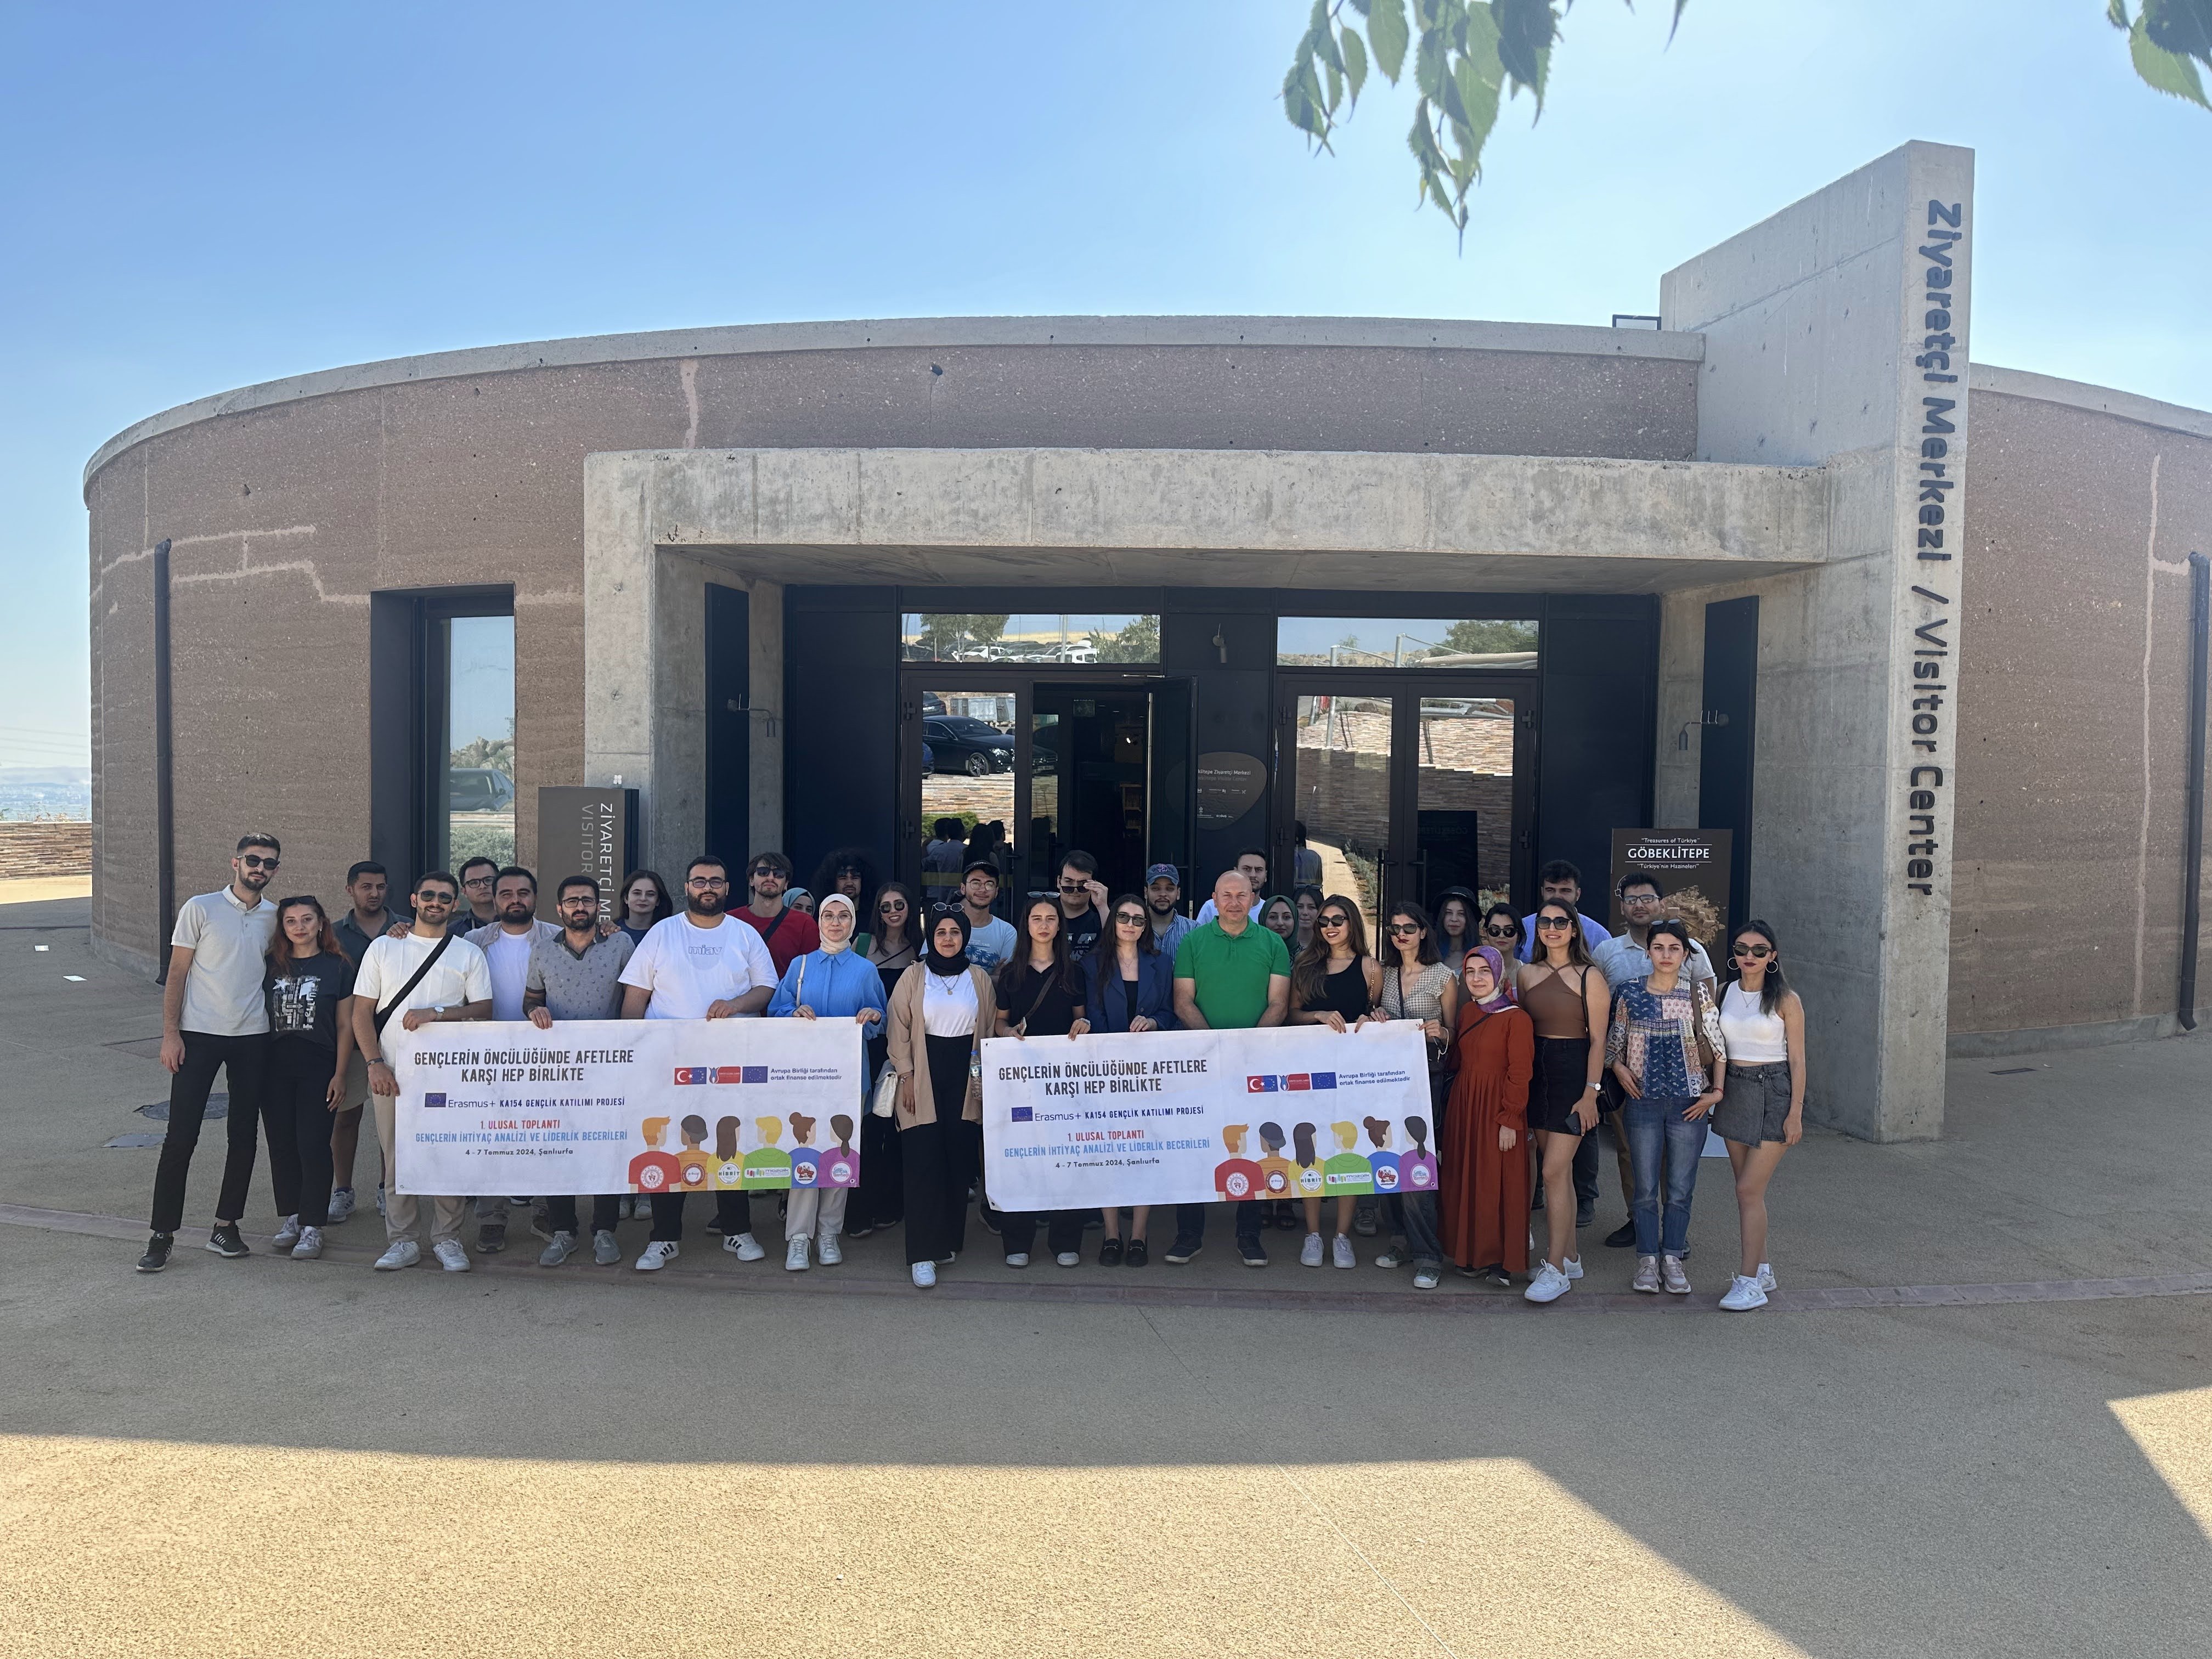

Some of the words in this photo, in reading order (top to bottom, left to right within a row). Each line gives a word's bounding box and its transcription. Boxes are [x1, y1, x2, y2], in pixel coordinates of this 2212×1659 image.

[1916, 199, 1962, 383] Ziyaretçi
[1917, 397, 1955, 561] Merkezi
[1912, 618, 1948, 753] Visitor
[582, 804, 594, 873] VISITOR
[1908, 766, 1943, 895] Center
[596, 803, 615, 891] ZİYARETÇİ
[1628, 846, 1709, 859] GÖBEKLİTEPE
[414, 1049, 479, 1069] GENÇLERİN
[484, 1048, 570, 1065] ÖNCÜLÜĞÜNDE
[575, 1049, 634, 1064] AFETLERE
[461, 1068, 496, 1085] KARŞI
[502, 1069, 524, 1081] HEP
[529, 1065, 584, 1081] BİRLİKTE
[998, 1063, 1060, 1082] GENÇLERİN
[1065, 1060, 1147, 1077] ÖNCÜLÜĞÜNDE
[1153, 1060, 1207, 1074] AFETLERE
[1045, 1082, 1079, 1098] KARŞI
[1084, 1081, 1105, 1094] HEP
[1110, 1076, 1162, 1093] BİRLİKTE
[448, 1099, 495, 1108] Erasmus+
[500, 1099, 522, 1108] KA154
[526, 1097, 556, 1109] GENÇLİK
[560, 1098, 593, 1107] KATILIMI
[596, 1096, 625, 1106] PROJESİ
[1035, 1113, 1081, 1121] Erasmus+
[1085, 1111, 1107, 1119] KA154
[1109, 1108, 1138, 1120] GENÇLİK
[1142, 1108, 1173, 1117] KATILIMI
[1176, 1105, 1204, 1115] PROJESİ
[480, 1120, 486, 1130] 1.
[488, 1120, 518, 1130] ULUSAL
[521, 1120, 560, 1129] TOPLANTI
[415, 1131, 457, 1145] GENÇLERİN
[460, 1131, 491, 1144] İHTİYAÇ
[494, 1130, 527, 1142] ANALİZİ
[530, 1133, 540, 1142] VE
[543, 1130, 579, 1142] LİDERLİK
[582, 1128, 628, 1141] BECERİLERİ
[1068, 1133, 1073, 1142] 1.
[1075, 1131, 1105, 1142] ULUSAL
[1108, 1130, 1144, 1139] TOPLANTI
[539, 1148, 573, 1156] Şanlıurfa
[1005, 1144, 1046, 1159] GENÇLERİN
[1048, 1143, 1080, 1156] İHTİYAÇ
[1083, 1142, 1114, 1154] ANALİZİ
[1117, 1143, 1126, 1152] VE
[1130, 1139, 1164, 1152] LİDERLİK
[1166, 1136, 1210, 1150] BECERİLERİ
[1127, 1158, 1160, 1166] Şanlıurfa
